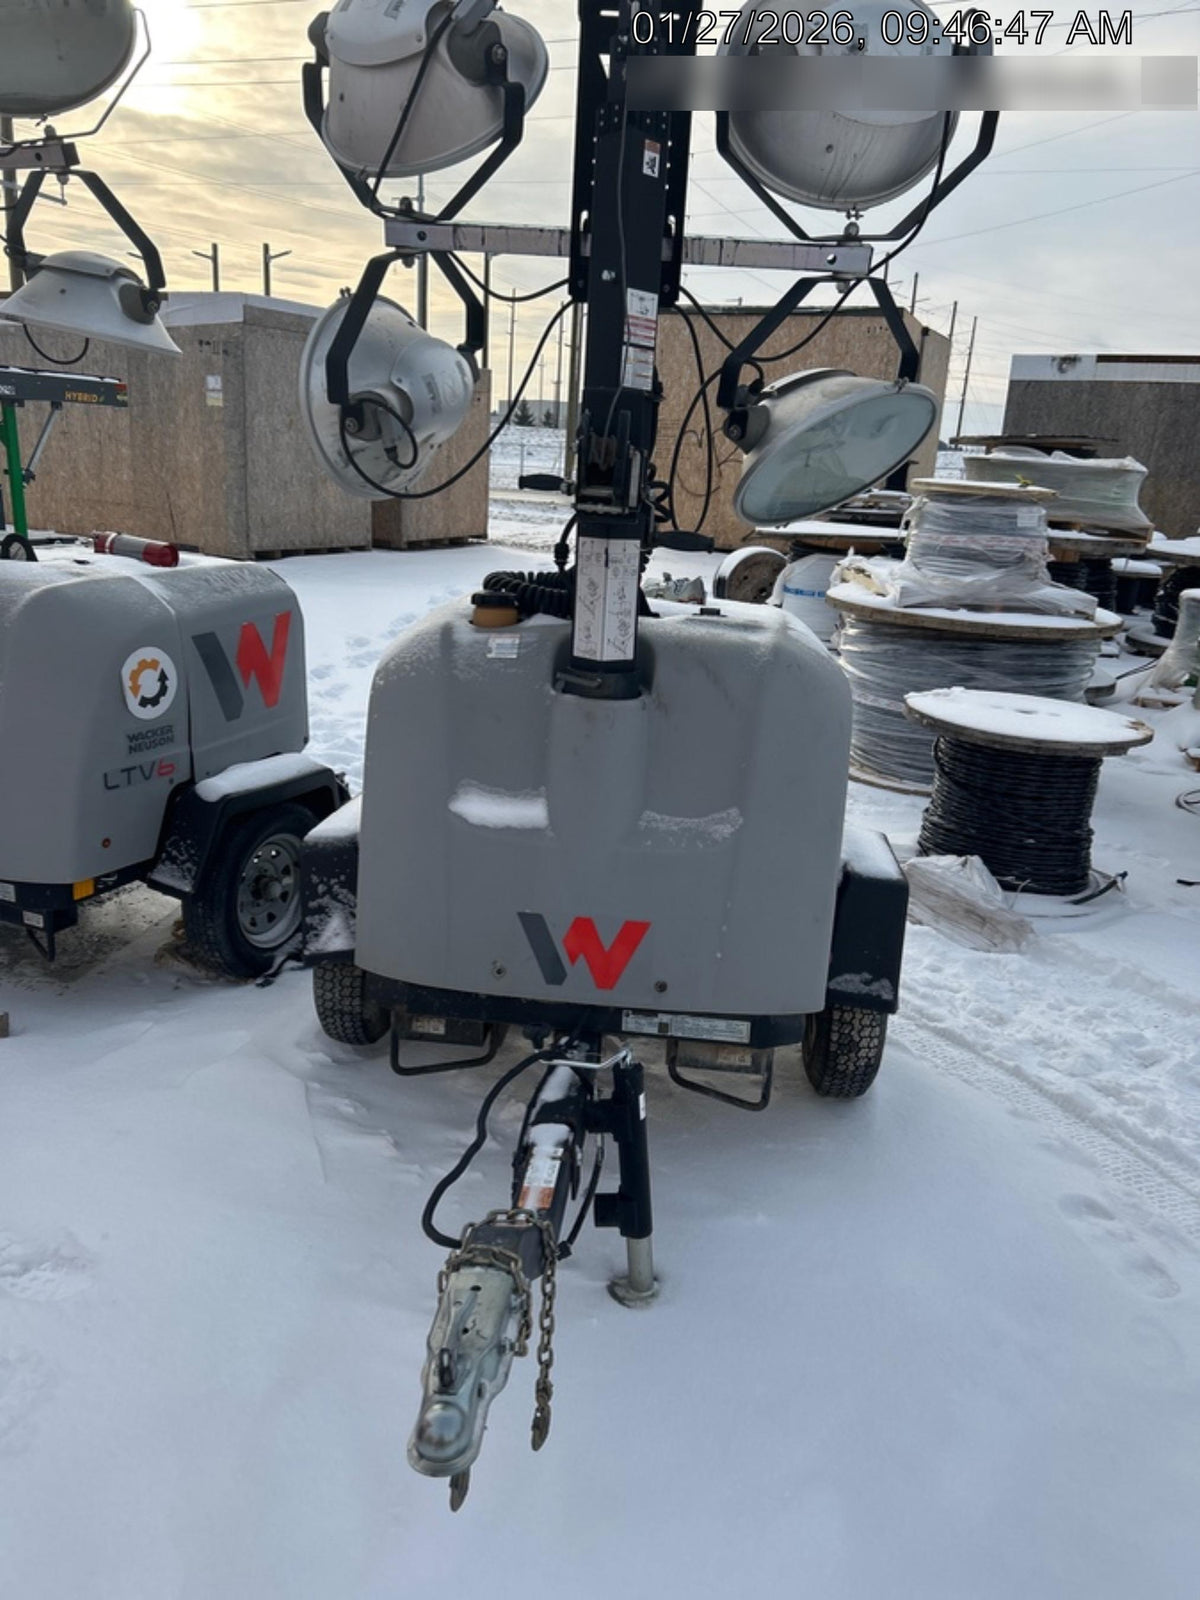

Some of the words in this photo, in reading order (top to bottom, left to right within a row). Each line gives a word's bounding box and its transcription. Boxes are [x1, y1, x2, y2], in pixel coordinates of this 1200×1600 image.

[64, 391, 98, 403] HYBRID
[126, 725, 174, 743] WACKER
[128, 735, 175, 754] NEUSON
[103, 757, 177, 790] LTV6
